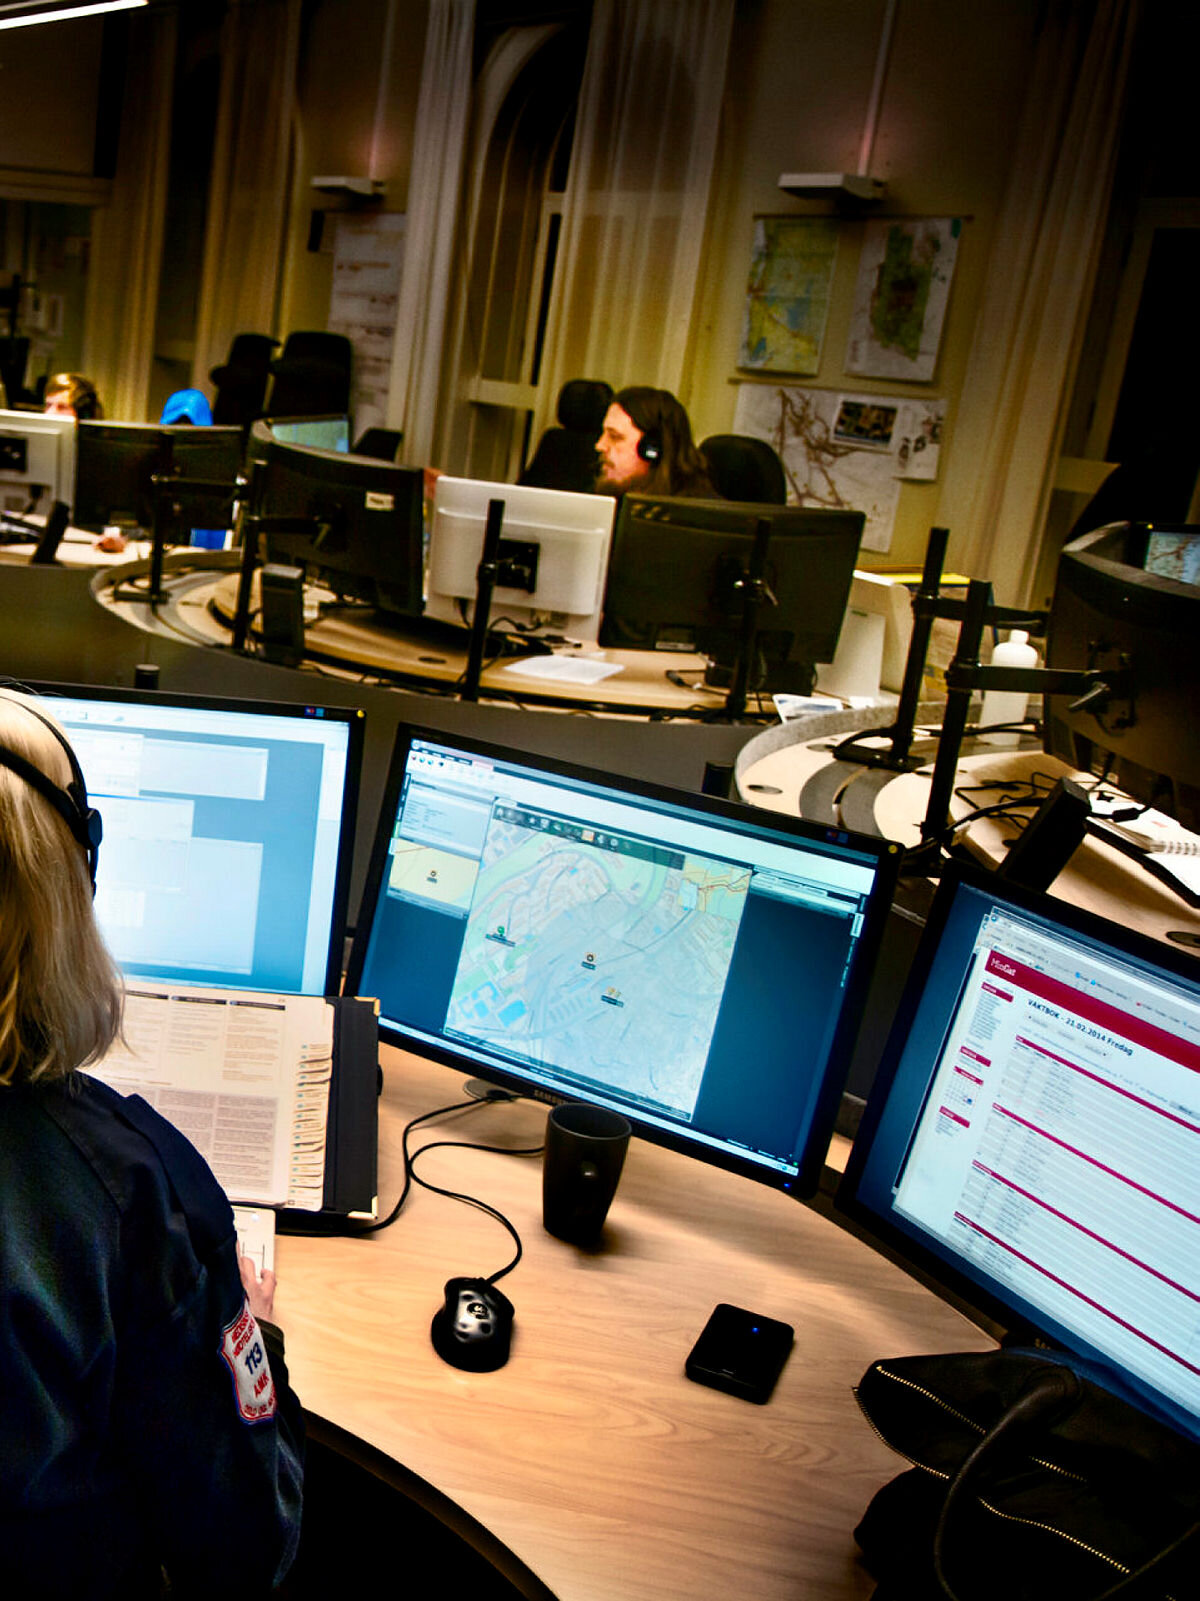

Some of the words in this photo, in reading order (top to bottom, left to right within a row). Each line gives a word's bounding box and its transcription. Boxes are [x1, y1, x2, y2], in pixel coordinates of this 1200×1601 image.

[1028, 999, 1061, 1019] VAKTBOK
[1065, 1017, 1106, 1042] 21.02.2014
[1106, 1037, 1134, 1057] Fredag
[245, 1342, 263, 1375] 113
